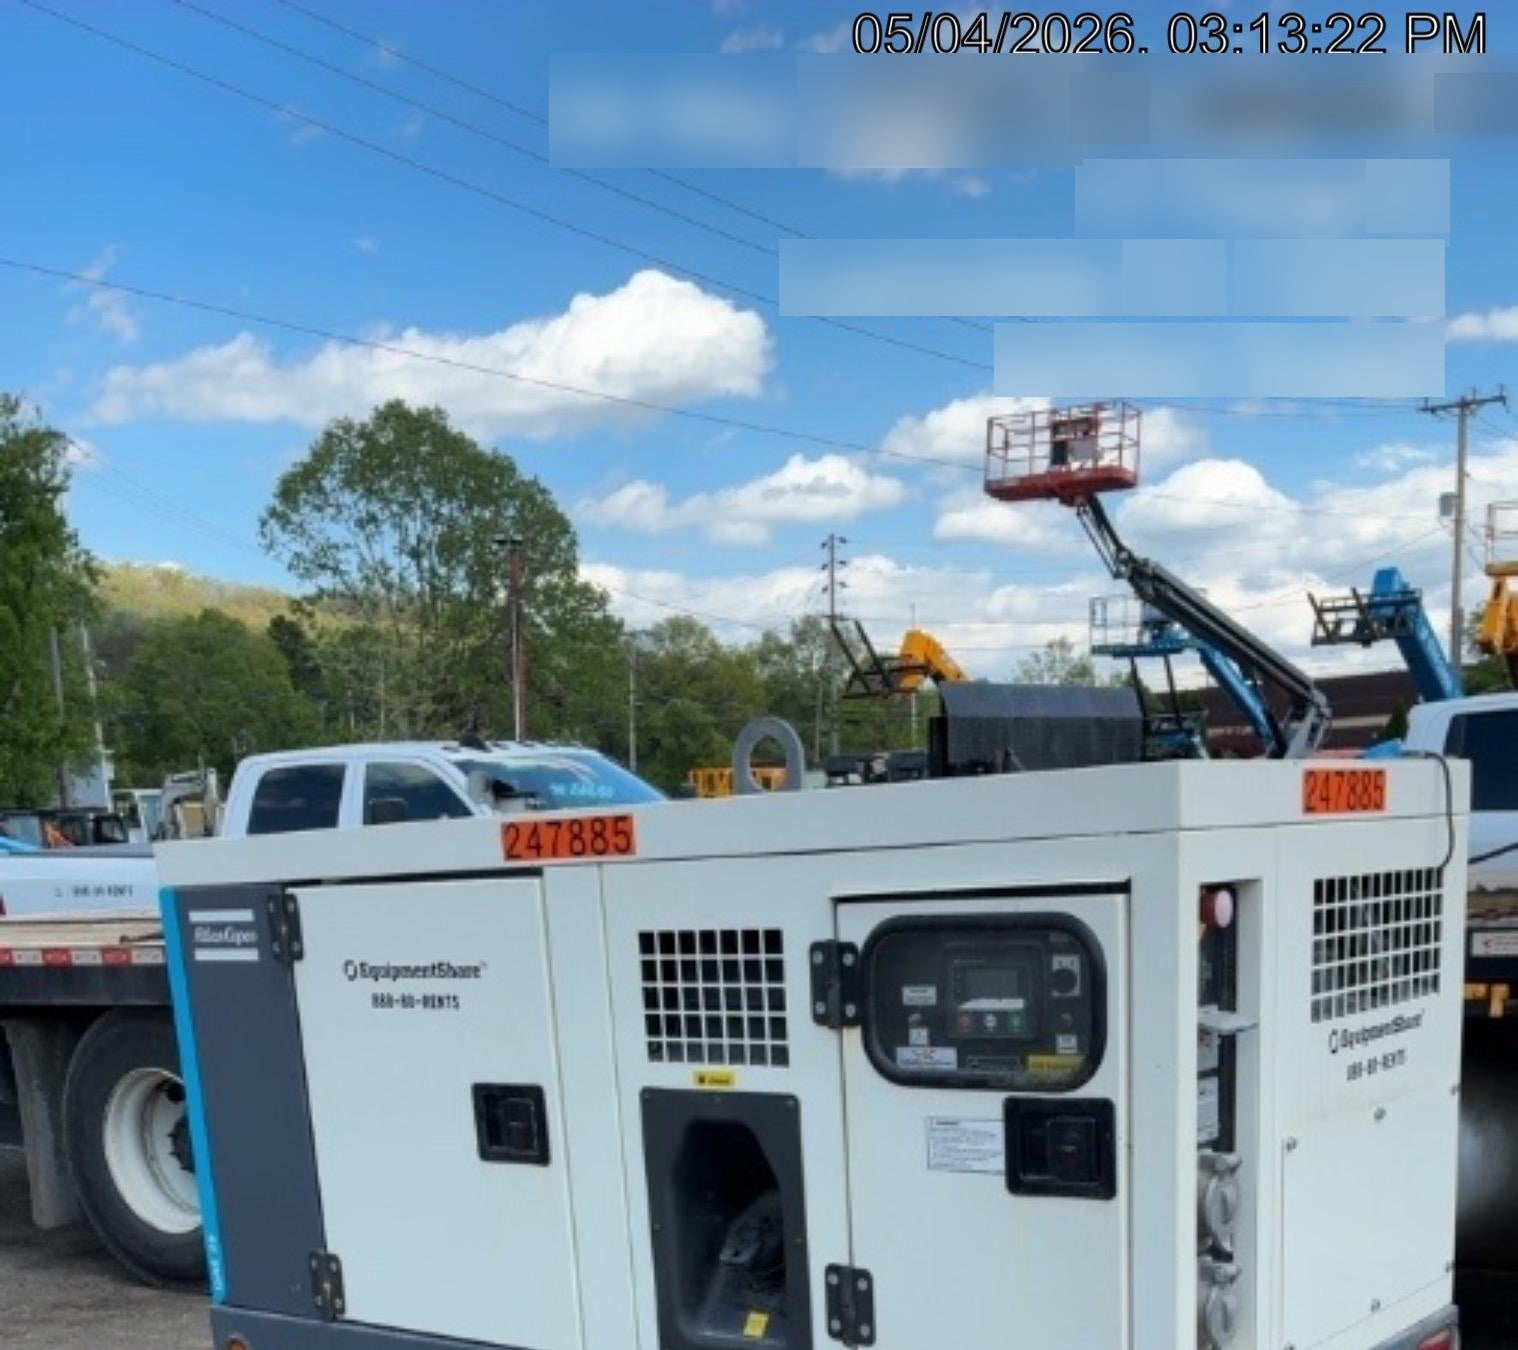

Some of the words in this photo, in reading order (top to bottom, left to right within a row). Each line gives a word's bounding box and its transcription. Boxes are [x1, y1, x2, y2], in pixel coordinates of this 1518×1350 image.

[1304, 769, 1385, 813] 247885
[503, 815, 632, 860] 247885
[359, 961, 481, 982] EquipmentShare
